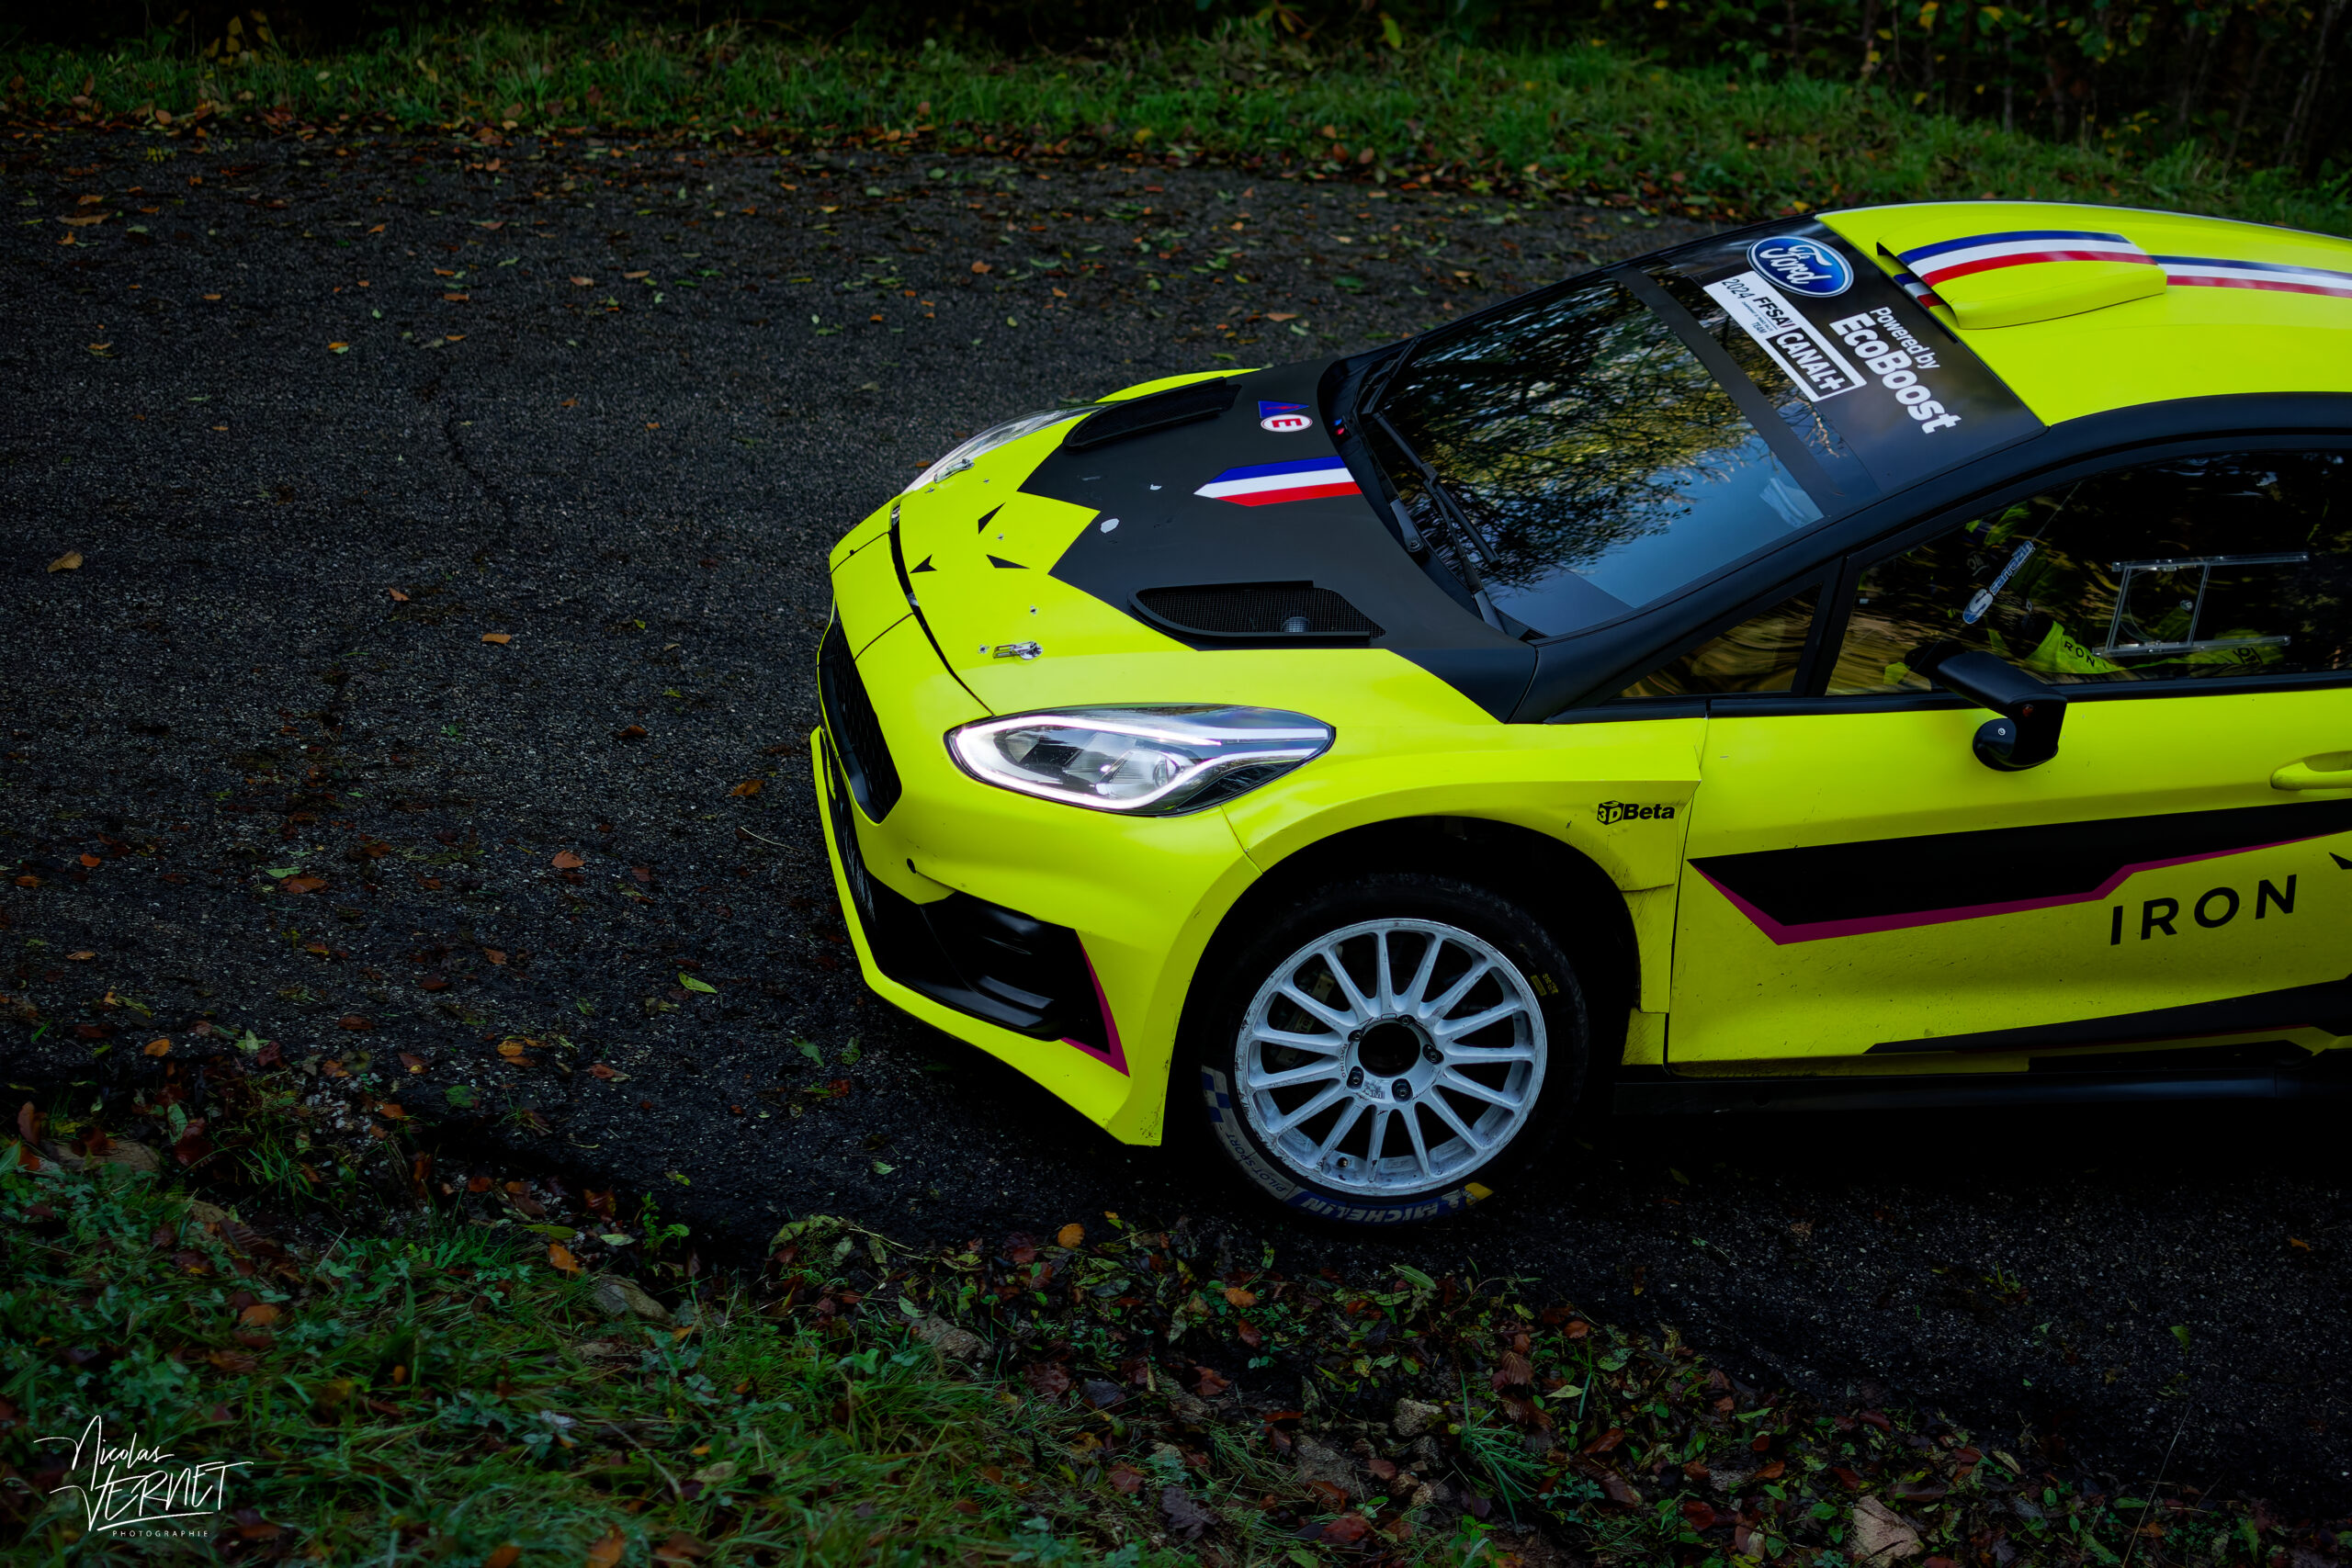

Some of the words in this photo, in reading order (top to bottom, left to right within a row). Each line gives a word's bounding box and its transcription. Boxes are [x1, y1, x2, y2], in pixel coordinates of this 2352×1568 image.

[1758, 244, 1833, 285] Ford
[1721, 278, 1756, 299] 2024
[1752, 296, 1792, 326] FFSA
[1870, 306, 1926, 360] Powered
[1918, 351, 1940, 369] by
[1775, 332, 1848, 391] CANAL+
[1829, 313, 1962, 434] EcoBoost
[1272, 418, 1303, 428] E
[1623, 804, 1676, 819] Beta
[2110, 874, 2297, 946] IRON
[1226, 1132, 1256, 1167] SPORT
[1251, 1168, 1287, 1191] PILOT
[1300, 1197, 1439, 1224] MICHELIN
